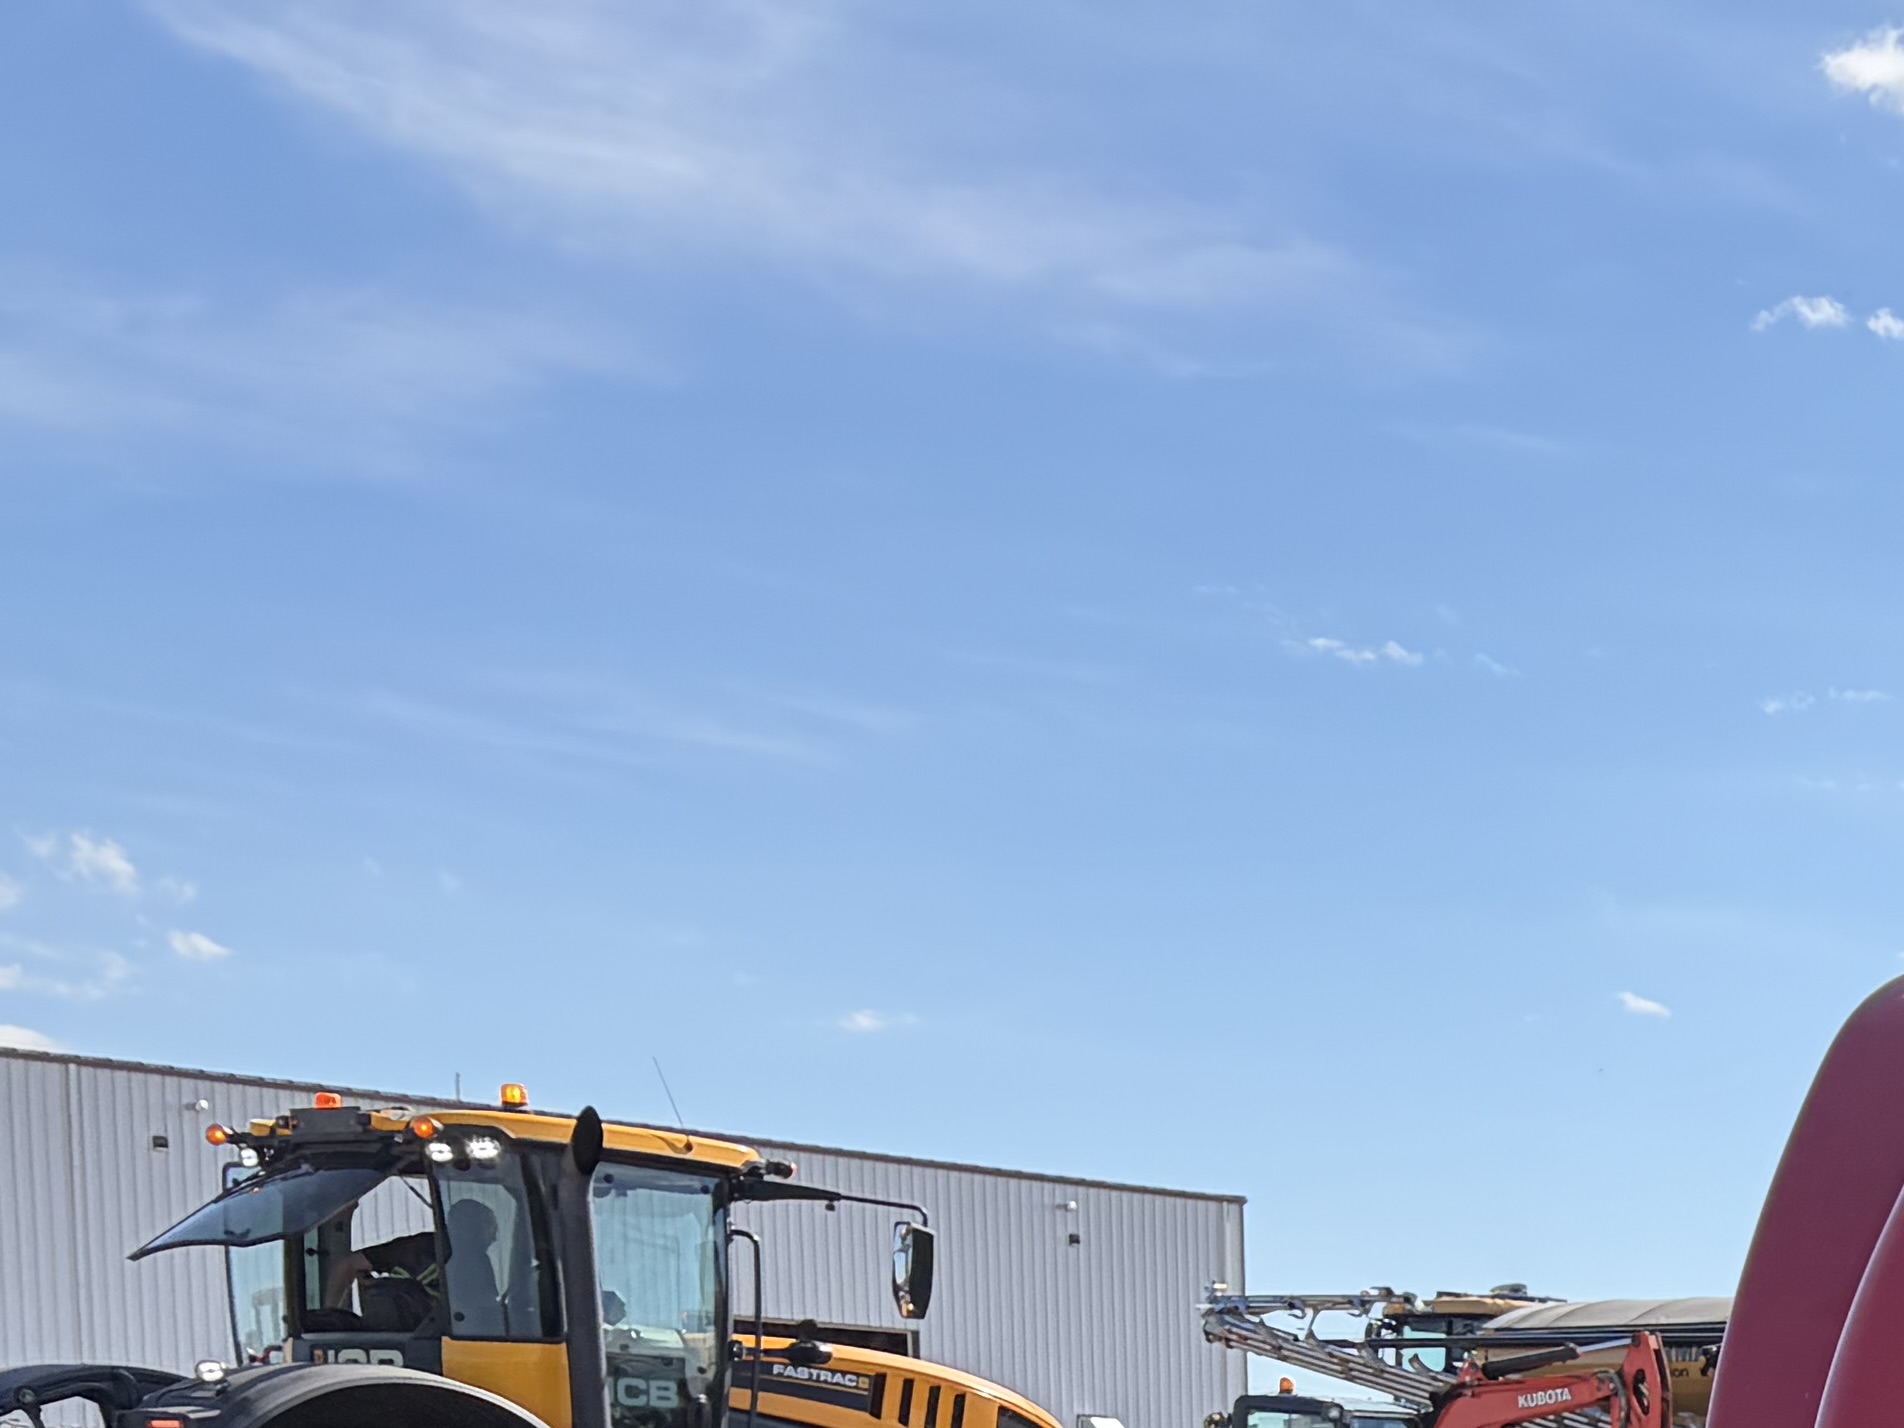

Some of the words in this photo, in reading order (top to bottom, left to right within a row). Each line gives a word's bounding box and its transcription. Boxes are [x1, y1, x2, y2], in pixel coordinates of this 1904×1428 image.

[772, 1364, 858, 1387] FASTRAC
[607, 1377, 679, 1408] CB
[1517, 1387, 1572, 1409] KUBOTA
